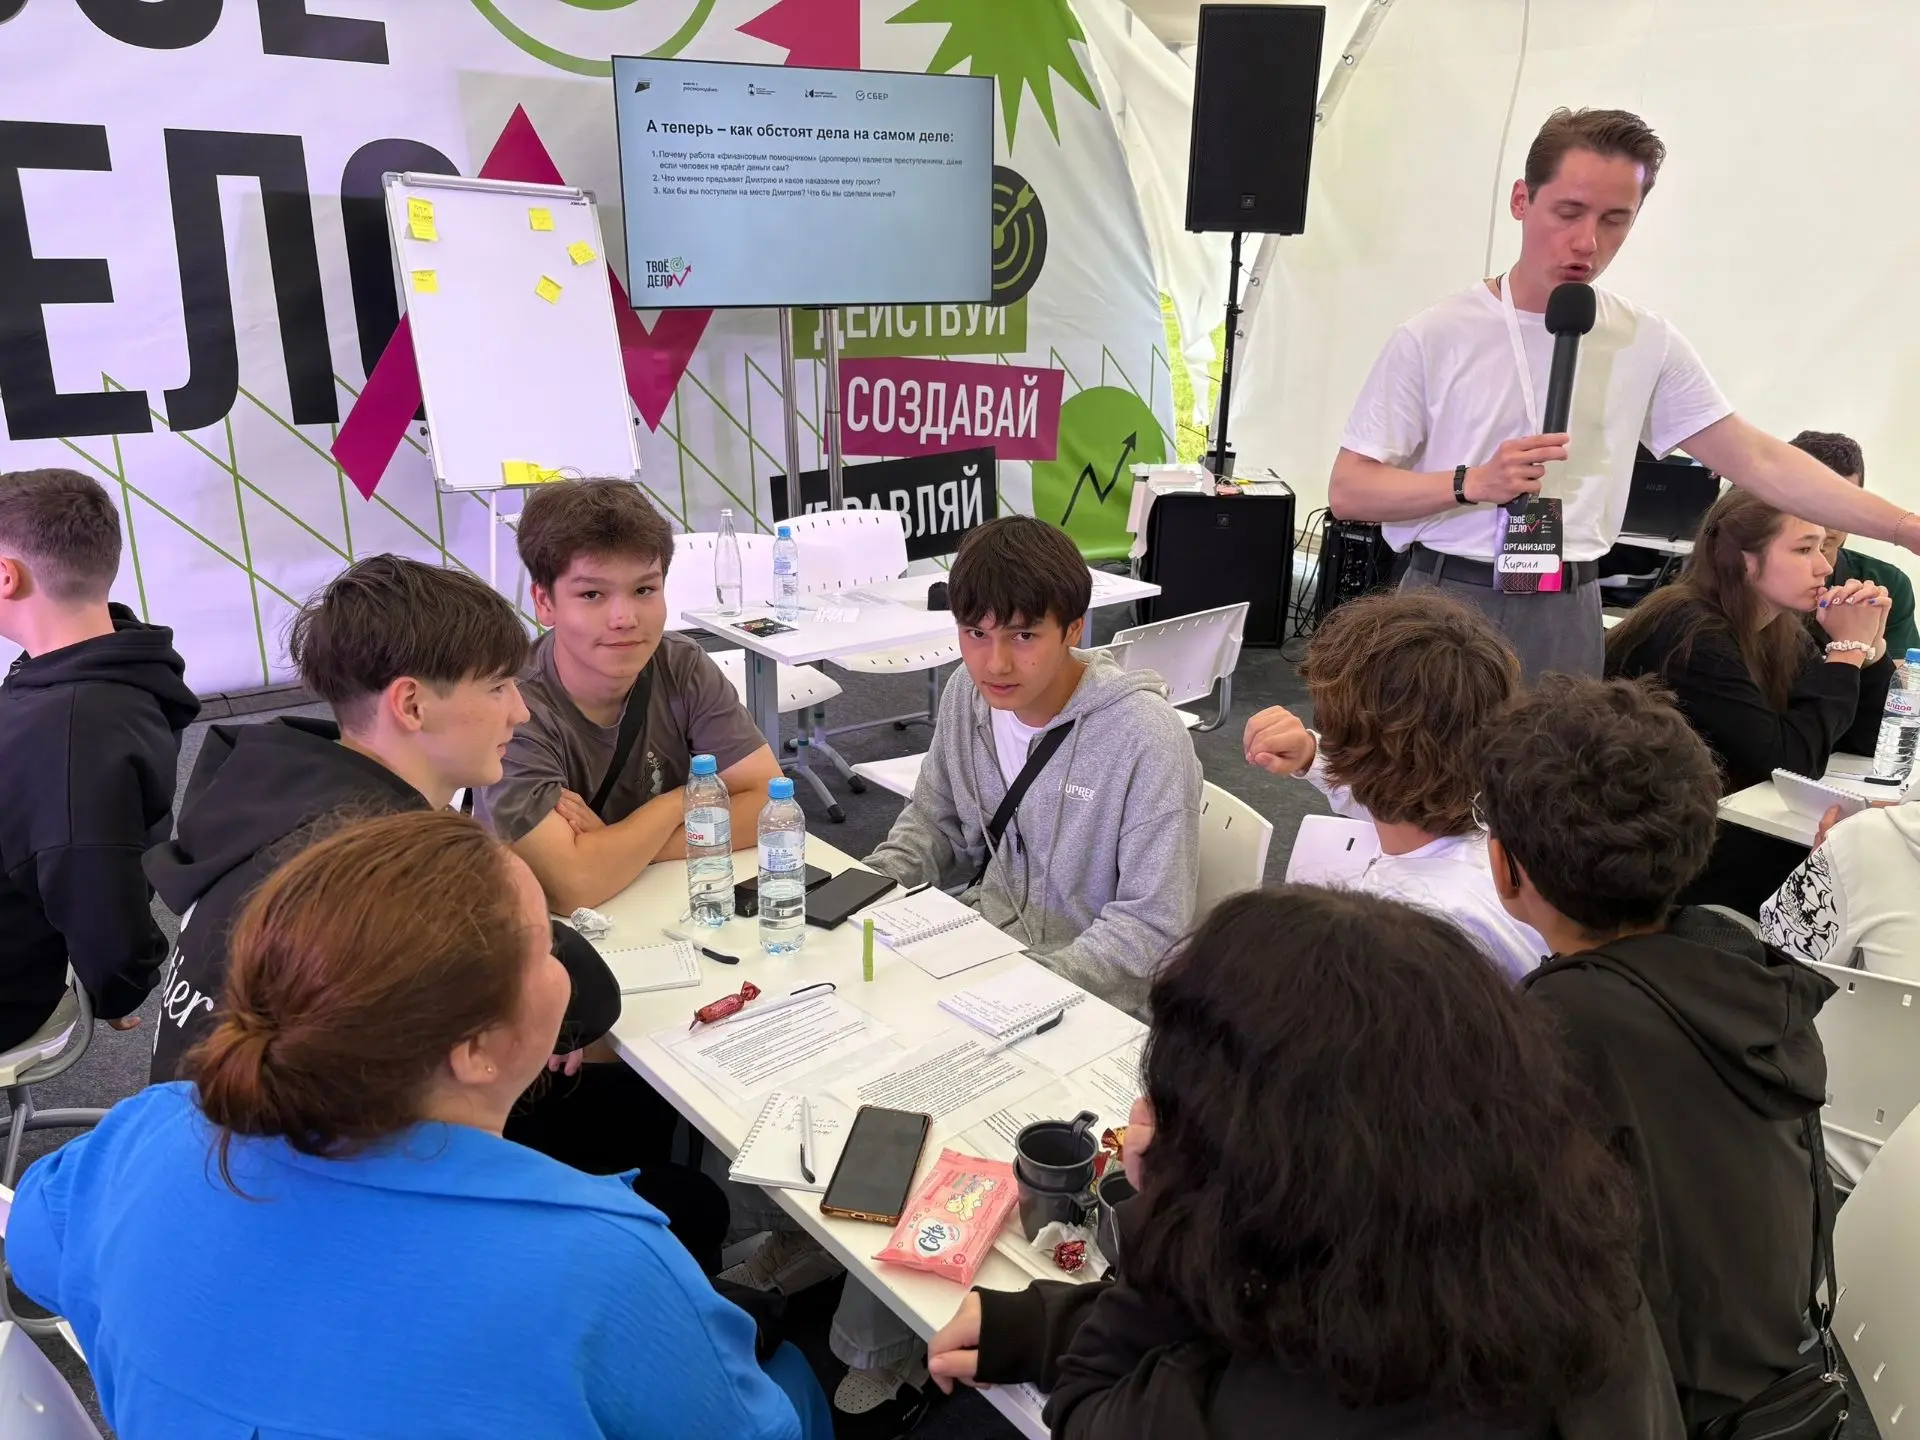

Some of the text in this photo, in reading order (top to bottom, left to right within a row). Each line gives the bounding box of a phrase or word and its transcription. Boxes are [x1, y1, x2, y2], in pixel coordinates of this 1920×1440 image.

[866, 92, 889, 100] СБЕР
[646, 119, 658, 133] А
[661, 122, 713, 137] теперь
[730, 124, 753, 136] как
[757, 124, 813, 138] обстоят
[816, 128, 850, 141] дела
[854, 130, 869, 140] на
[873, 130, 916, 142] самом
[919, 132, 954, 144] деле:
[659, 150, 687, 160] Почему
[689, 151, 715, 160] работа
[720, 164, 746, 172] крадёт
[746, 164, 772, 172] деньги
[772, 164, 790, 172] сам?
[652, 174, 660, 182] 2.
[661, 174, 676, 182] Что
[745, 176, 778, 184] Дмитрию
[856, 178, 881, 186] грозит?
[653, 187, 660, 195] 3.
[662, 187, 675, 195] Как
[676, 187, 688, 195] бы
[700, 188, 738, 196] поступили
[821, 189, 831, 197] бы
[646, 258, 670, 273] ТВОЁ
[647, 274, 674, 289] ДЕЛО
[846, 374, 1039, 445] СОЗДАВАЙ
[804, 463, 984, 540] ВЛЯЙ
[1509, 514, 1526, 524] ТВОЁ
[1508, 525, 1528, 534] ДЕЛО
[1503, 543, 1556, 552] ОРГАНИЗАТОР
[1502, 556, 1539, 572] Кирилл
